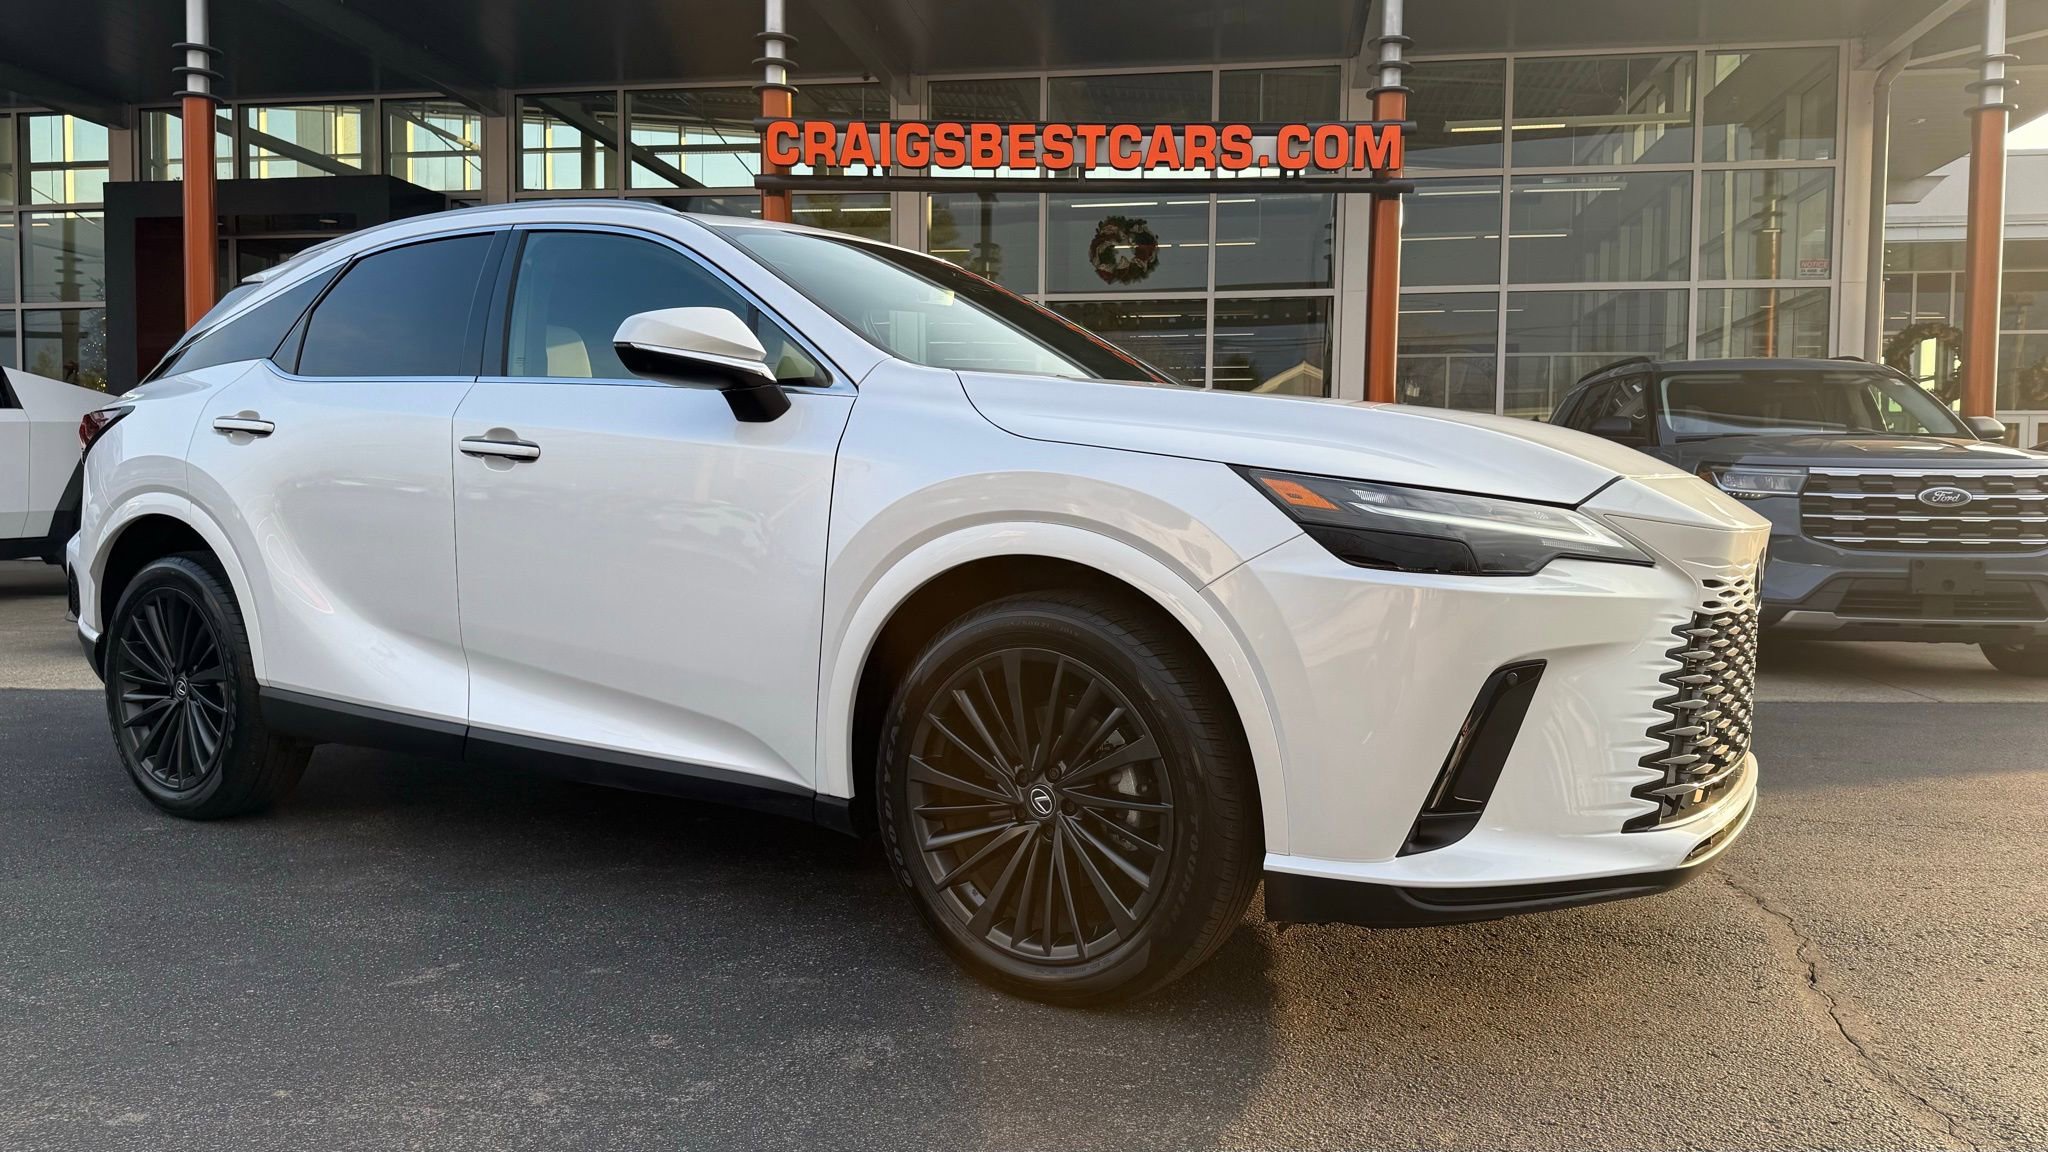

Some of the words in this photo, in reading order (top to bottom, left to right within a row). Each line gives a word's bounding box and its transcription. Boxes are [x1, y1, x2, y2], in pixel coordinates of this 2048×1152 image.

[766, 121, 1402, 171] CRAIGSBESTCARS.COM
[1932, 490, 1961, 502] Ford
[883, 702, 913, 887] GOODYEAR
